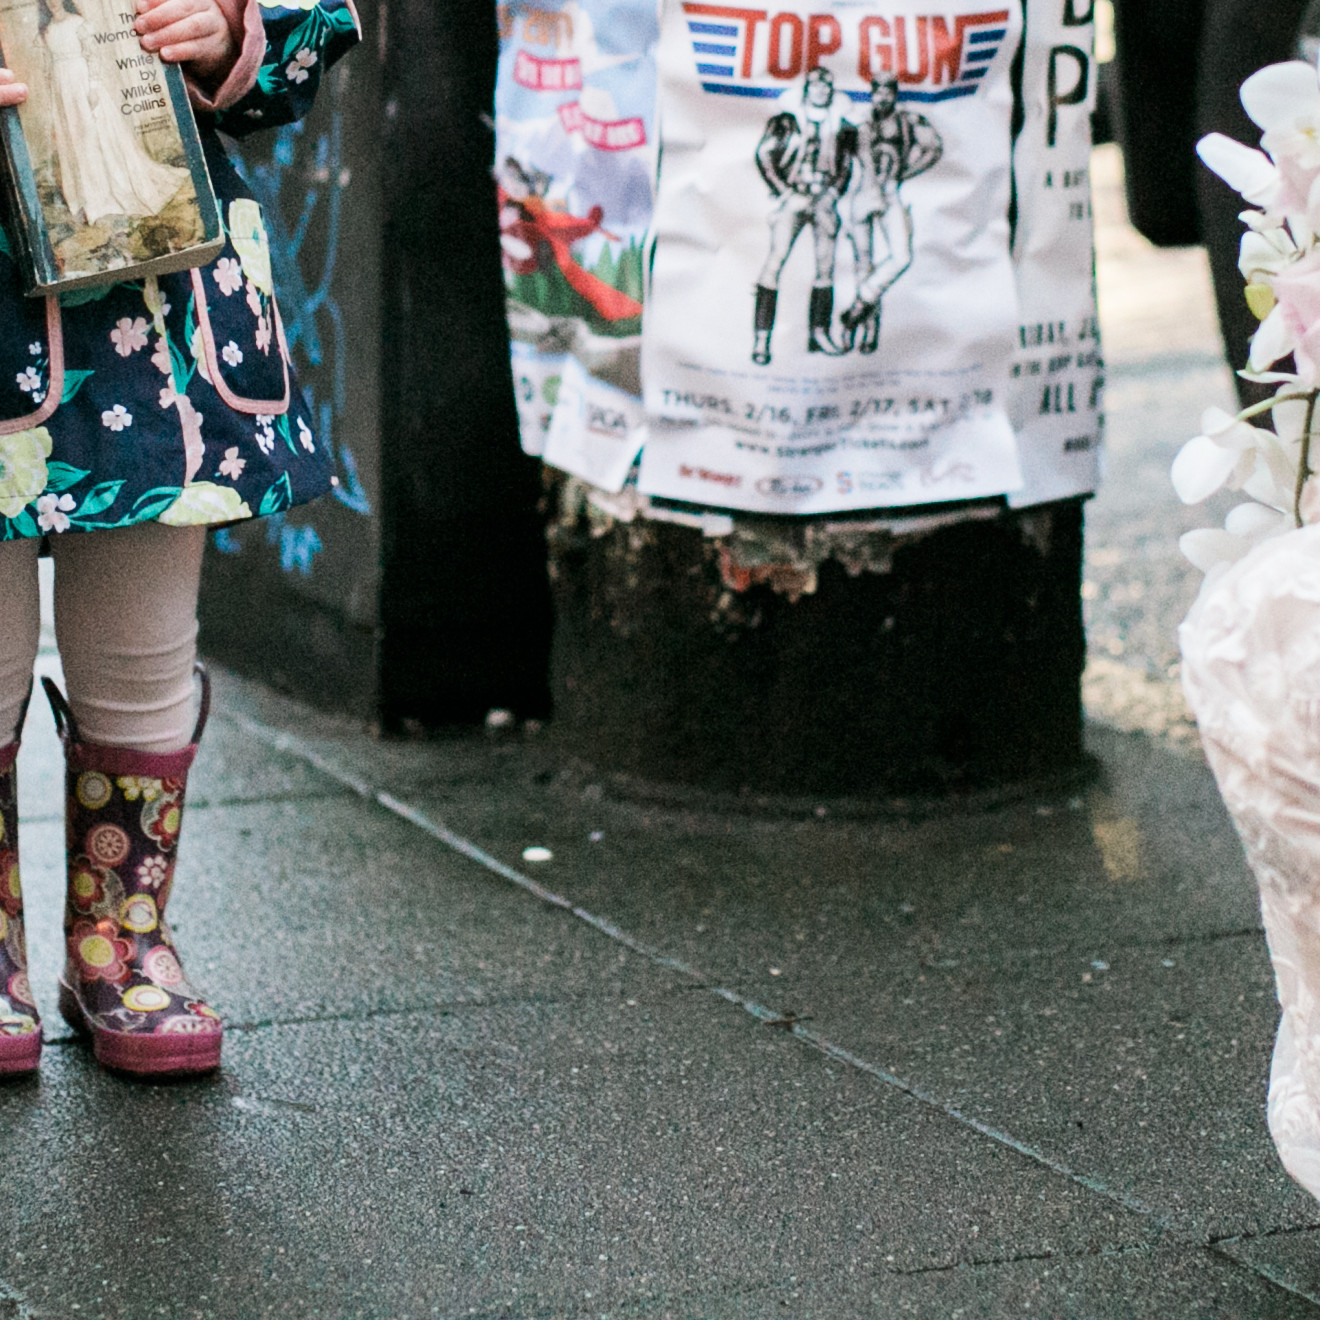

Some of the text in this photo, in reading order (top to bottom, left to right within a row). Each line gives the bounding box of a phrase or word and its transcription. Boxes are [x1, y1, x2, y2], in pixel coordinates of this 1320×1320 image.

[681, 1, 1010, 86] TOP GUN
[115, 54, 154, 71] White
[140, 69, 158, 81] by
[120, 83, 162, 101] Wilkie
[120, 97, 167, 116] Collins
